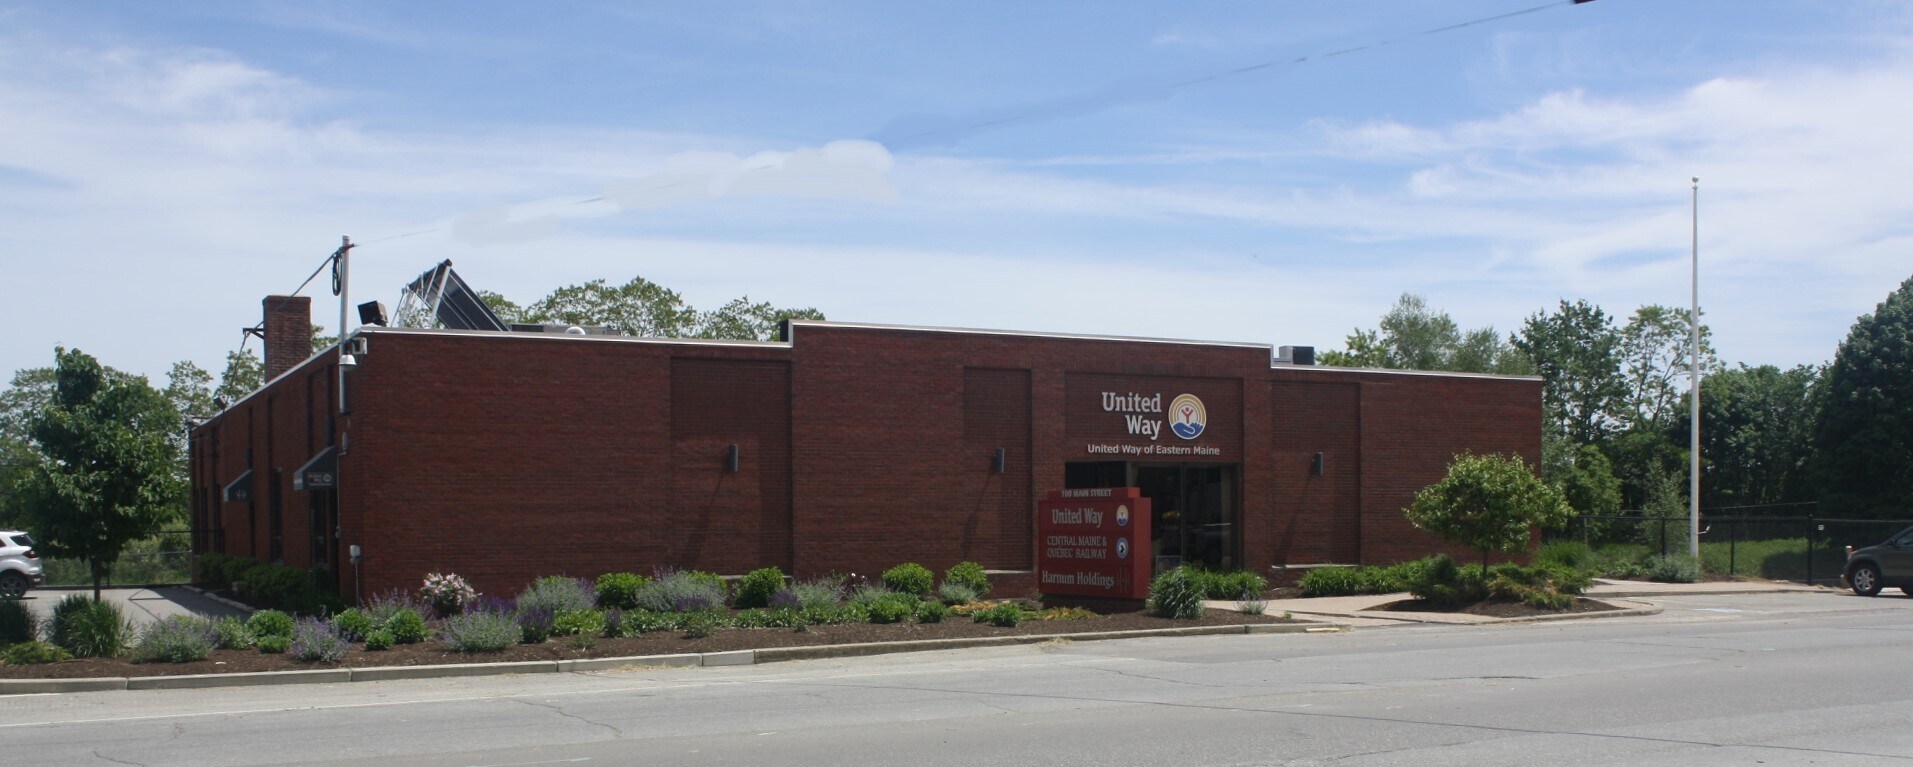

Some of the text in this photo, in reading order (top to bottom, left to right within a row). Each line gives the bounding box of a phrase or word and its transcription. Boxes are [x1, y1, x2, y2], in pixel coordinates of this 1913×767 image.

[1102, 392, 1161, 412] United
[1125, 415, 1161, 440] Way
[1087, 444, 1220, 456] United Way of Eastern Maine
[1074, 489, 1089, 498] MAIN
[1090, 488, 1112, 497] STREET
[1052, 508, 1103, 528] United Way
[1047, 536, 1107, 546] CENTRAL MAINE &
[1076, 549, 1107, 560] RAILWAY
[1042, 571, 1114, 590] Harnum Holdings
